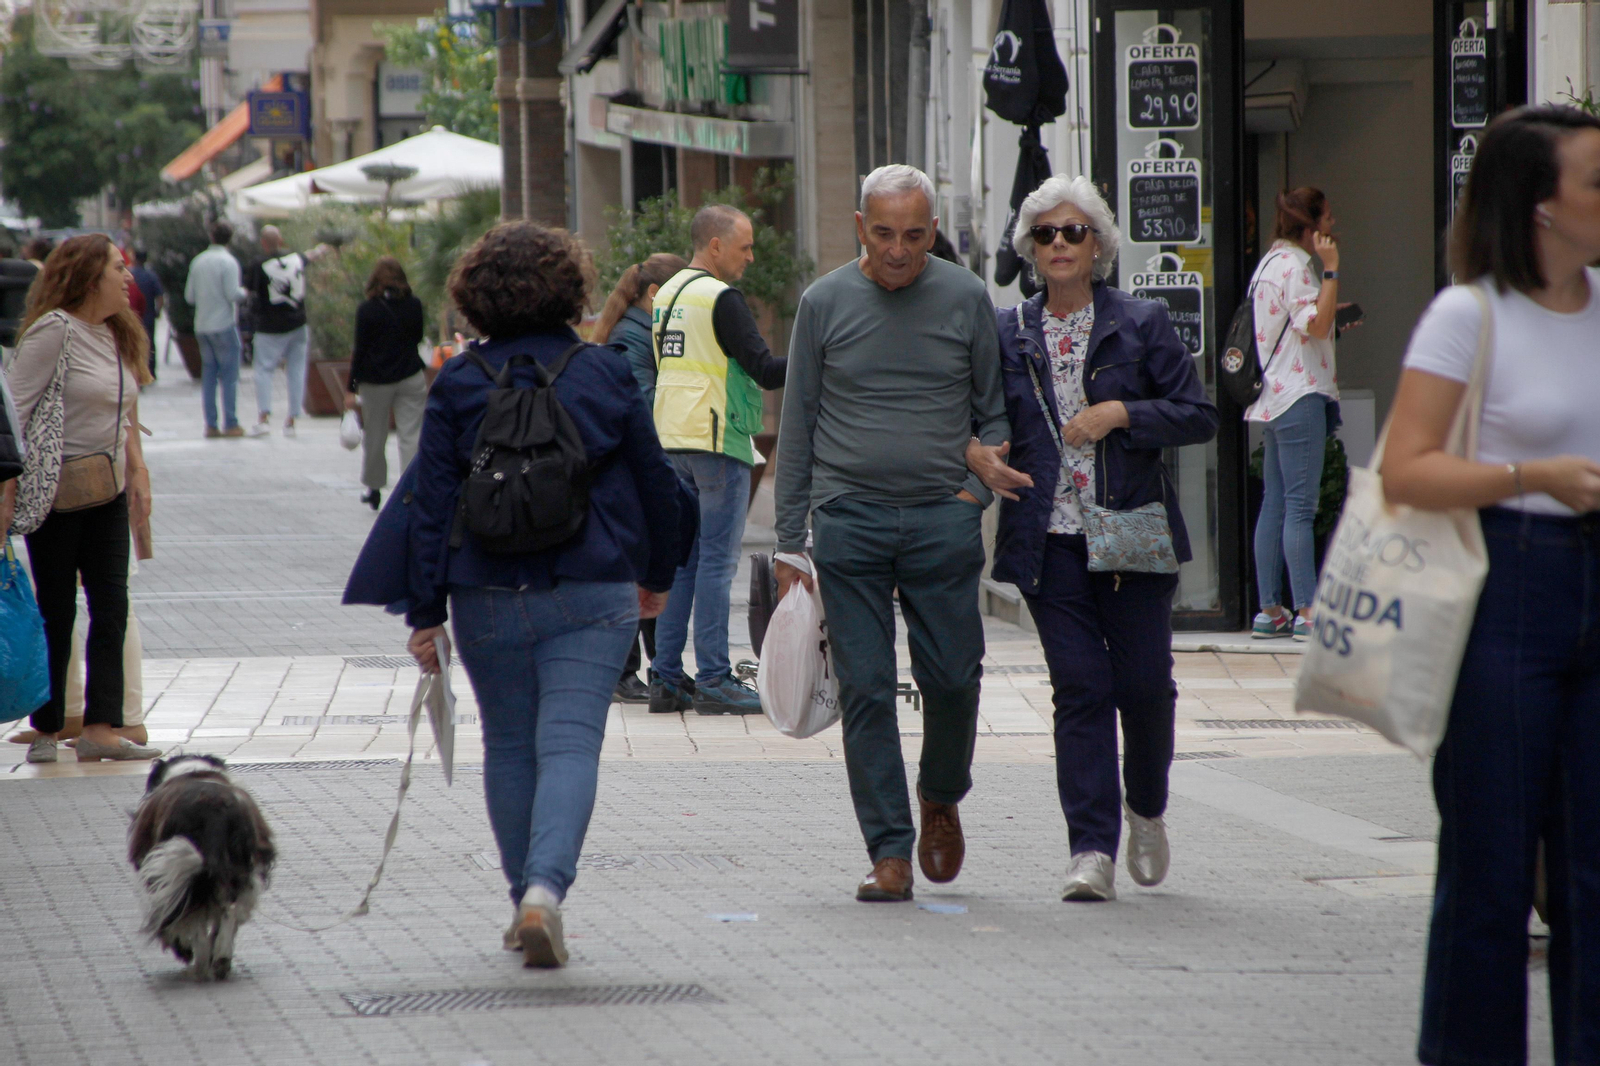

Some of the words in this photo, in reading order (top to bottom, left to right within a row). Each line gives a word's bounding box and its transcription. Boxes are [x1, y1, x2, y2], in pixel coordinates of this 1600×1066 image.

[749, 0, 777, 31] T
[1129, 46, 1196, 59] OFERTA
[1453, 41, 1485, 53] OFERTA
[1164, 65, 1175, 75] DE
[1140, 92, 1198, 125] 29,90
[1130, 161, 1197, 174] OFERTA
[1135, 178, 1166, 193] CAÑA
[1169, 180, 1181, 189] DE
[1175, 192, 1187, 202] DE
[1141, 217, 1186, 238] 53,90
[1133, 273, 1200, 286] OFERTA
